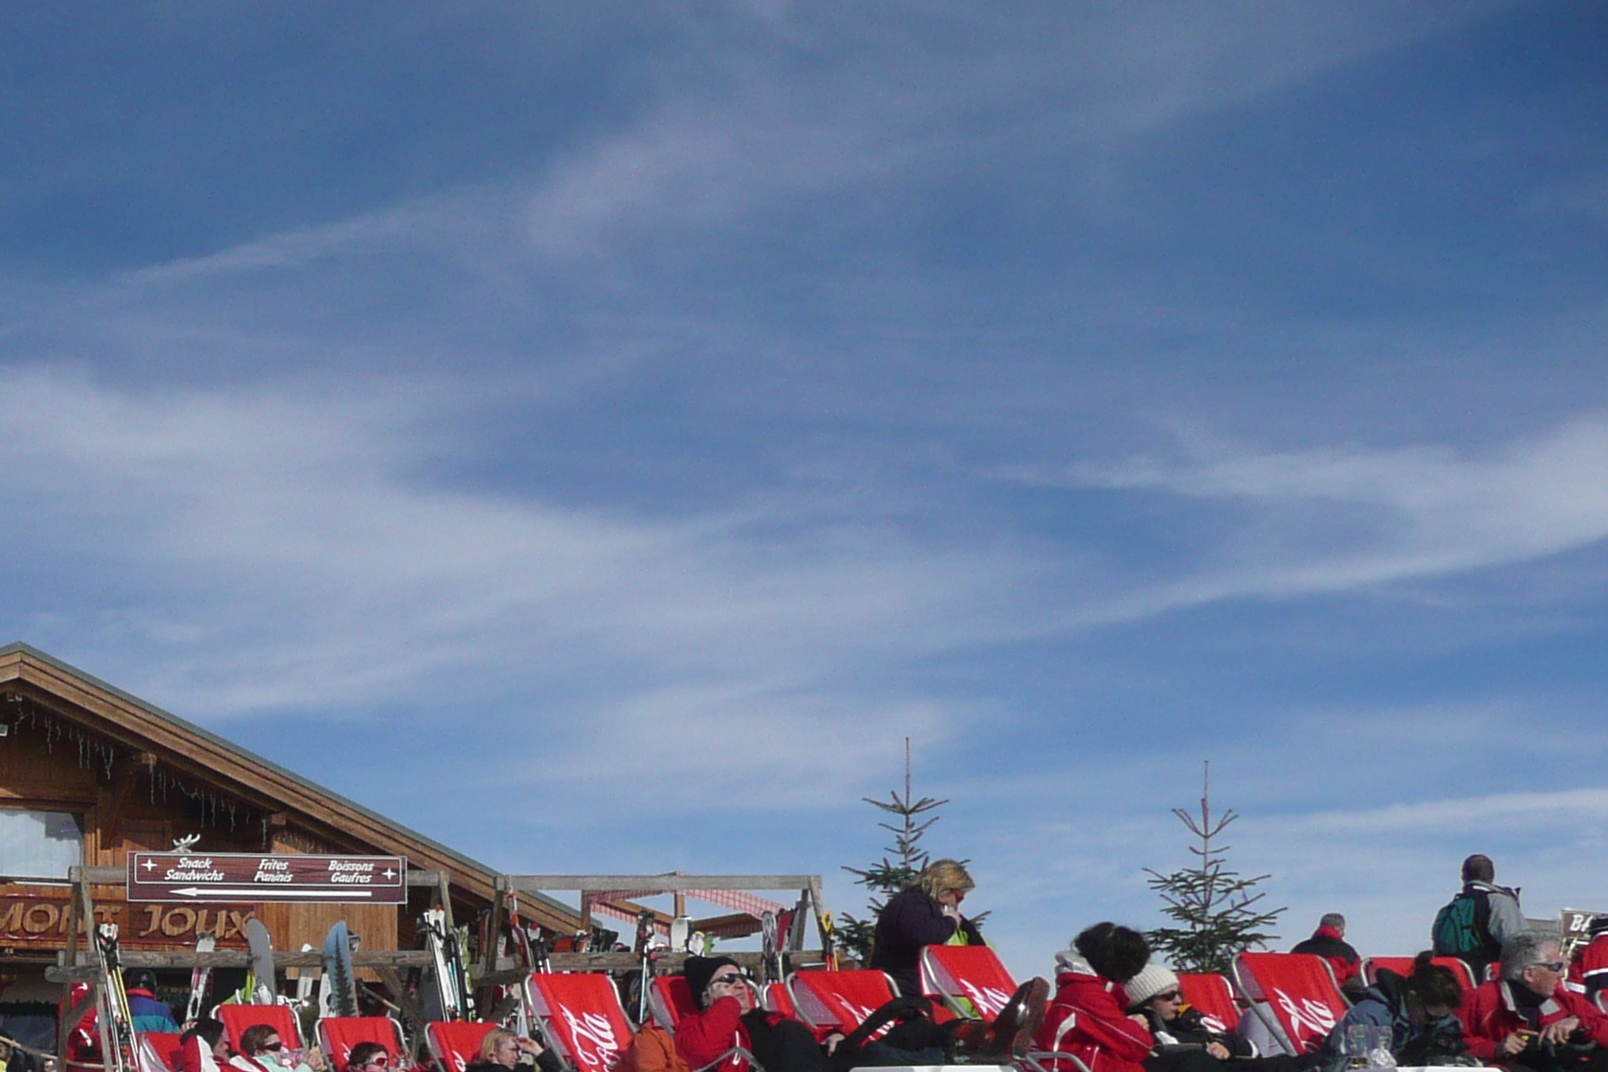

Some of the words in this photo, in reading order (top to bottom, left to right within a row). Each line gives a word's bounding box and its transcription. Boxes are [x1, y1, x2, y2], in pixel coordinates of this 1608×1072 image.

[177, 857, 212, 869] Snack
[258, 858, 289, 871] Frites
[328, 860, 374, 872] Boissons
[164, 869, 225, 882] Sandwichs
[254, 870, 293, 883] Paninis
[331, 872, 372, 884] Gaufres
[138, 904, 257, 939] JOUX
